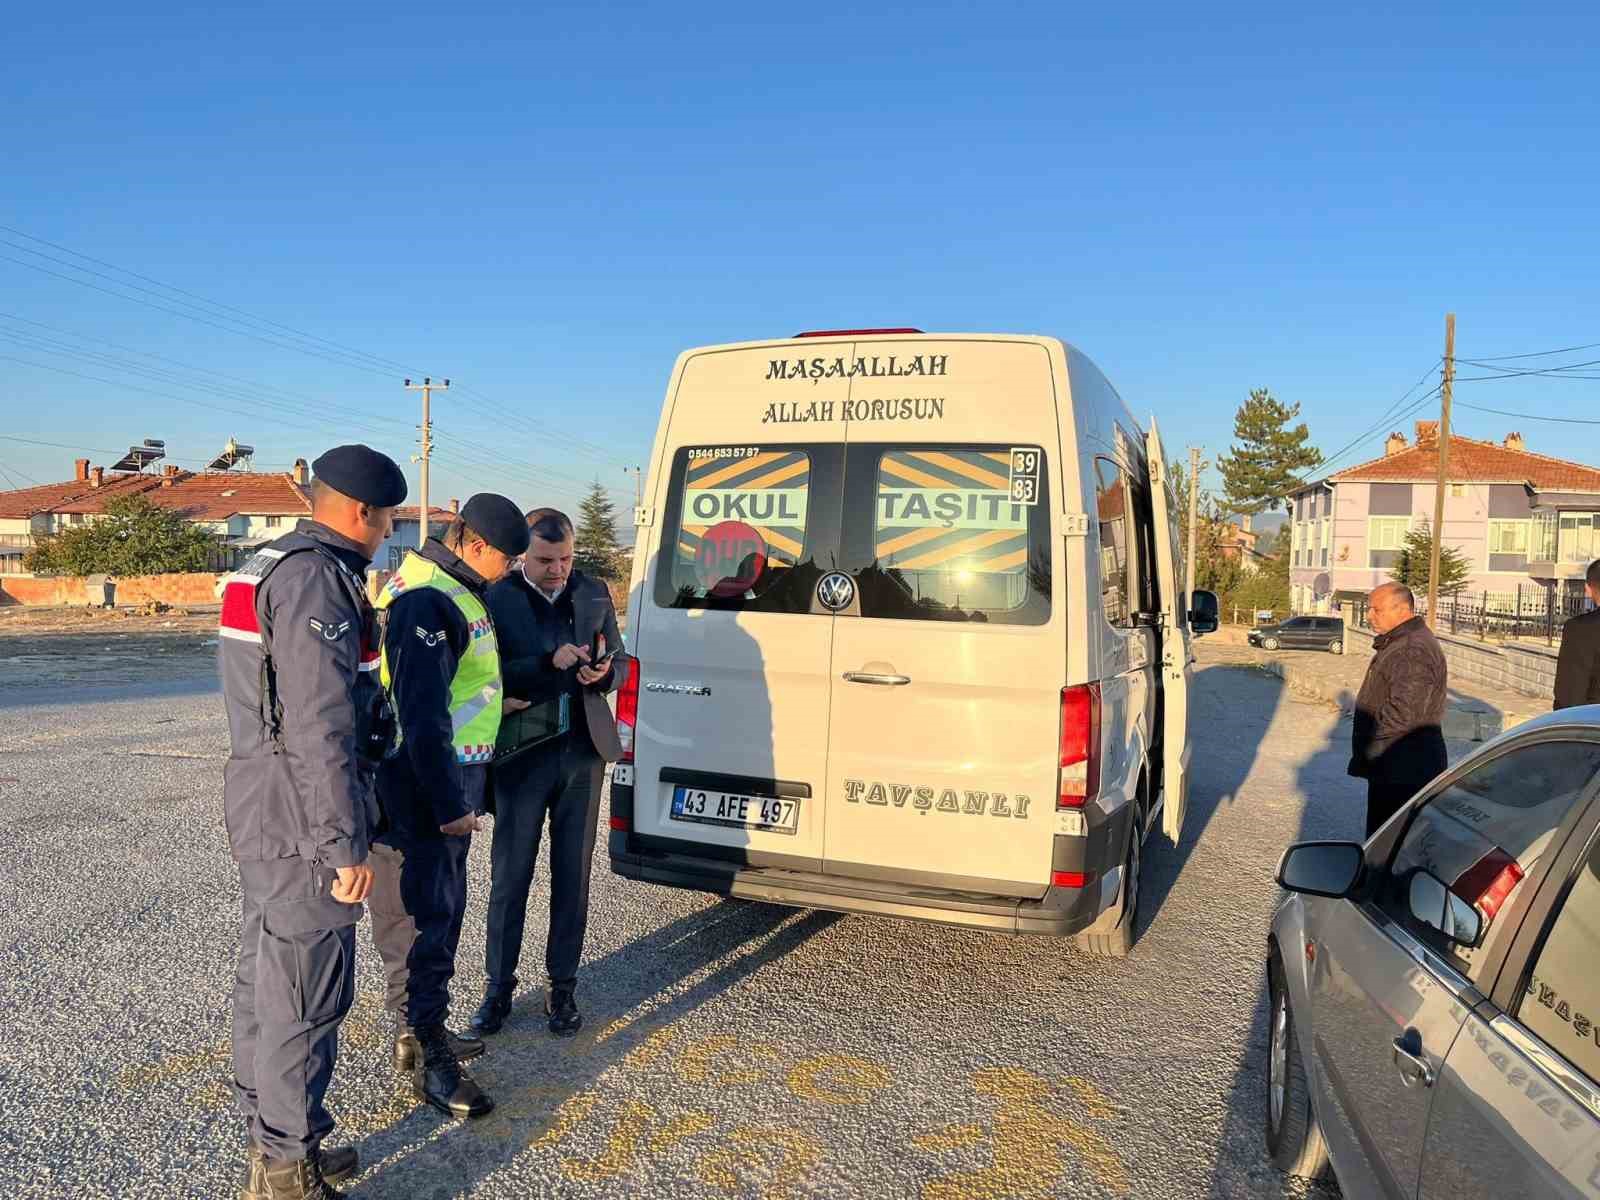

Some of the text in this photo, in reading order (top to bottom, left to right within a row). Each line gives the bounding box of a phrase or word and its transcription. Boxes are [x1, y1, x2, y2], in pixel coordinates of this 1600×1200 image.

[765, 354, 949, 385] MAŞAALLAH
[762, 398, 945, 424] ALLAH KORUSUN
[1014, 453, 1035, 472] 39
[1013, 479, 1033, 499] 83
[692, 493, 798, 519] OKUL
[685, 791, 706, 814] 43
[716, 795, 750, 820] AFE
[760, 799, 793, 825] 497
[844, 779, 1031, 819] TAVŞANLI
